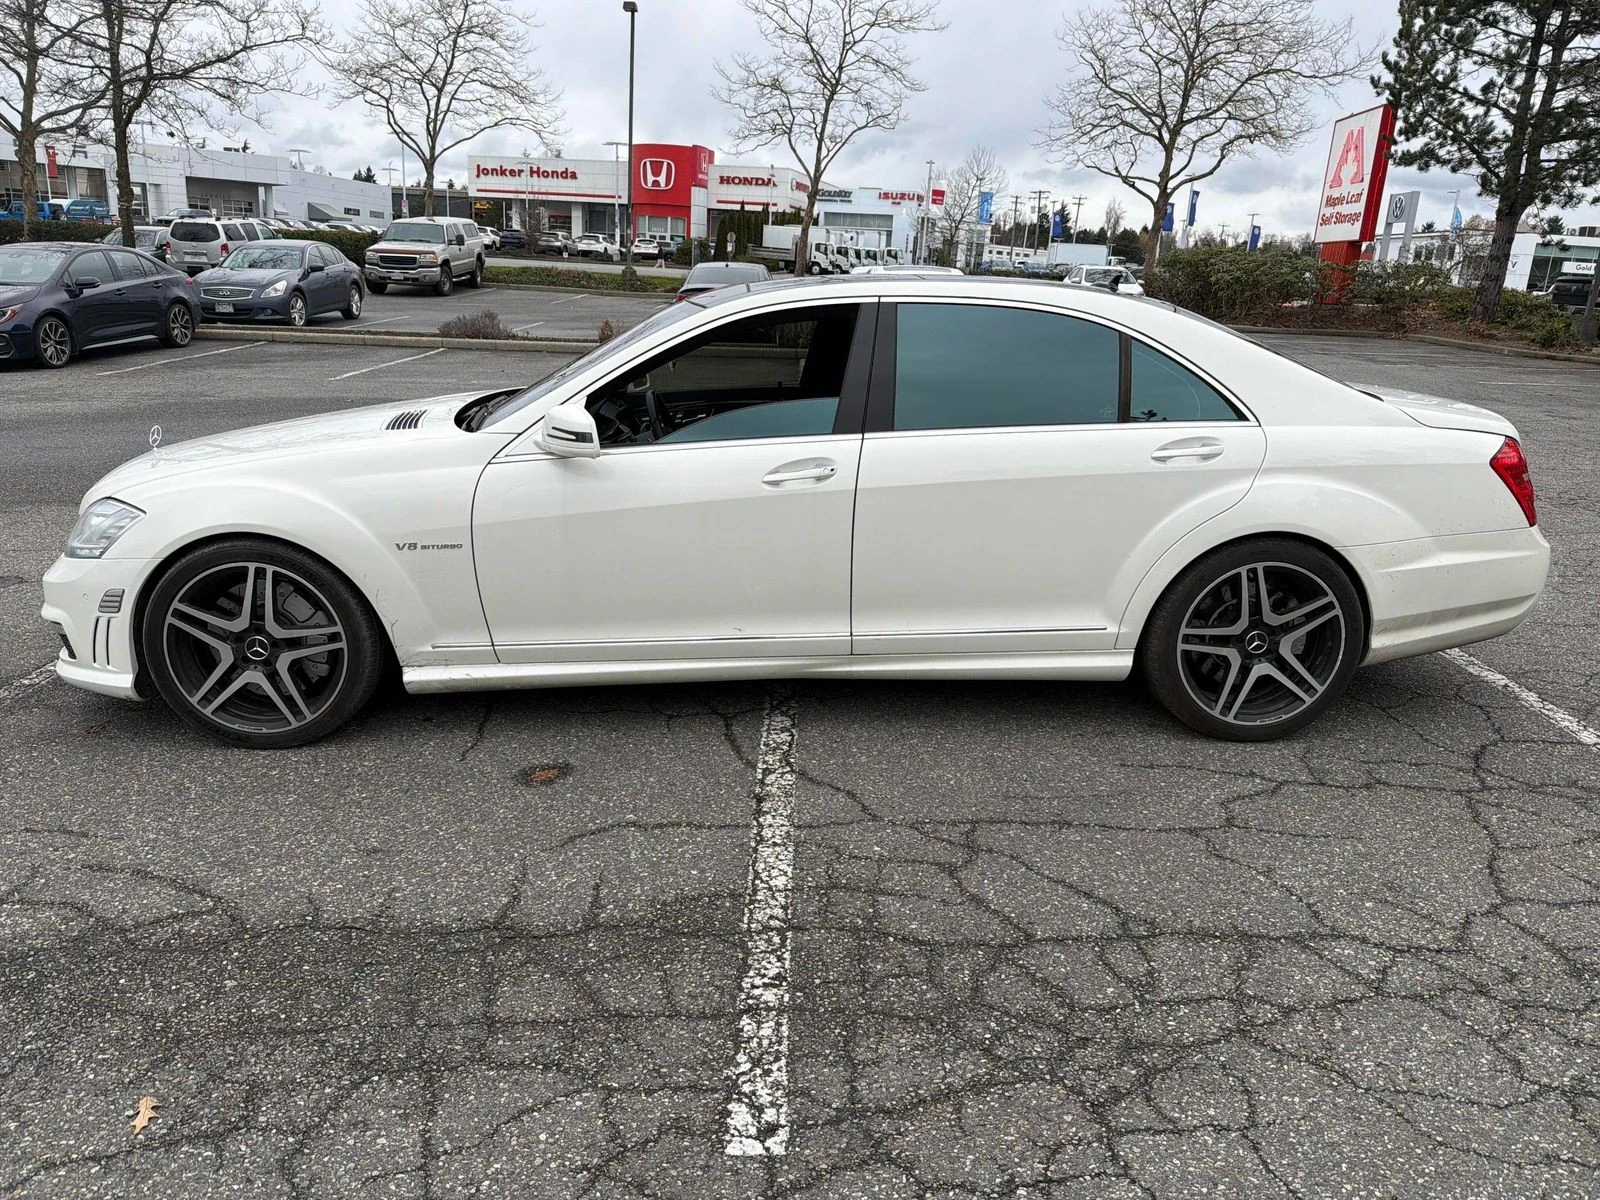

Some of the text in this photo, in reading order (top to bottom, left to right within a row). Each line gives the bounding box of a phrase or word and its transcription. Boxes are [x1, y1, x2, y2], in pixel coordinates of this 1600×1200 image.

[476, 164, 578, 180] Jonker Honda
[718, 175, 778, 187] HONDA
[878, 191, 916, 201] ISUZU
[1325, 188, 1364, 209] Maple Leaf
[1319, 211, 1361, 227] Self Storage
[1575, 263, 1593, 271] Gold
[395, 542, 418, 551] V8
